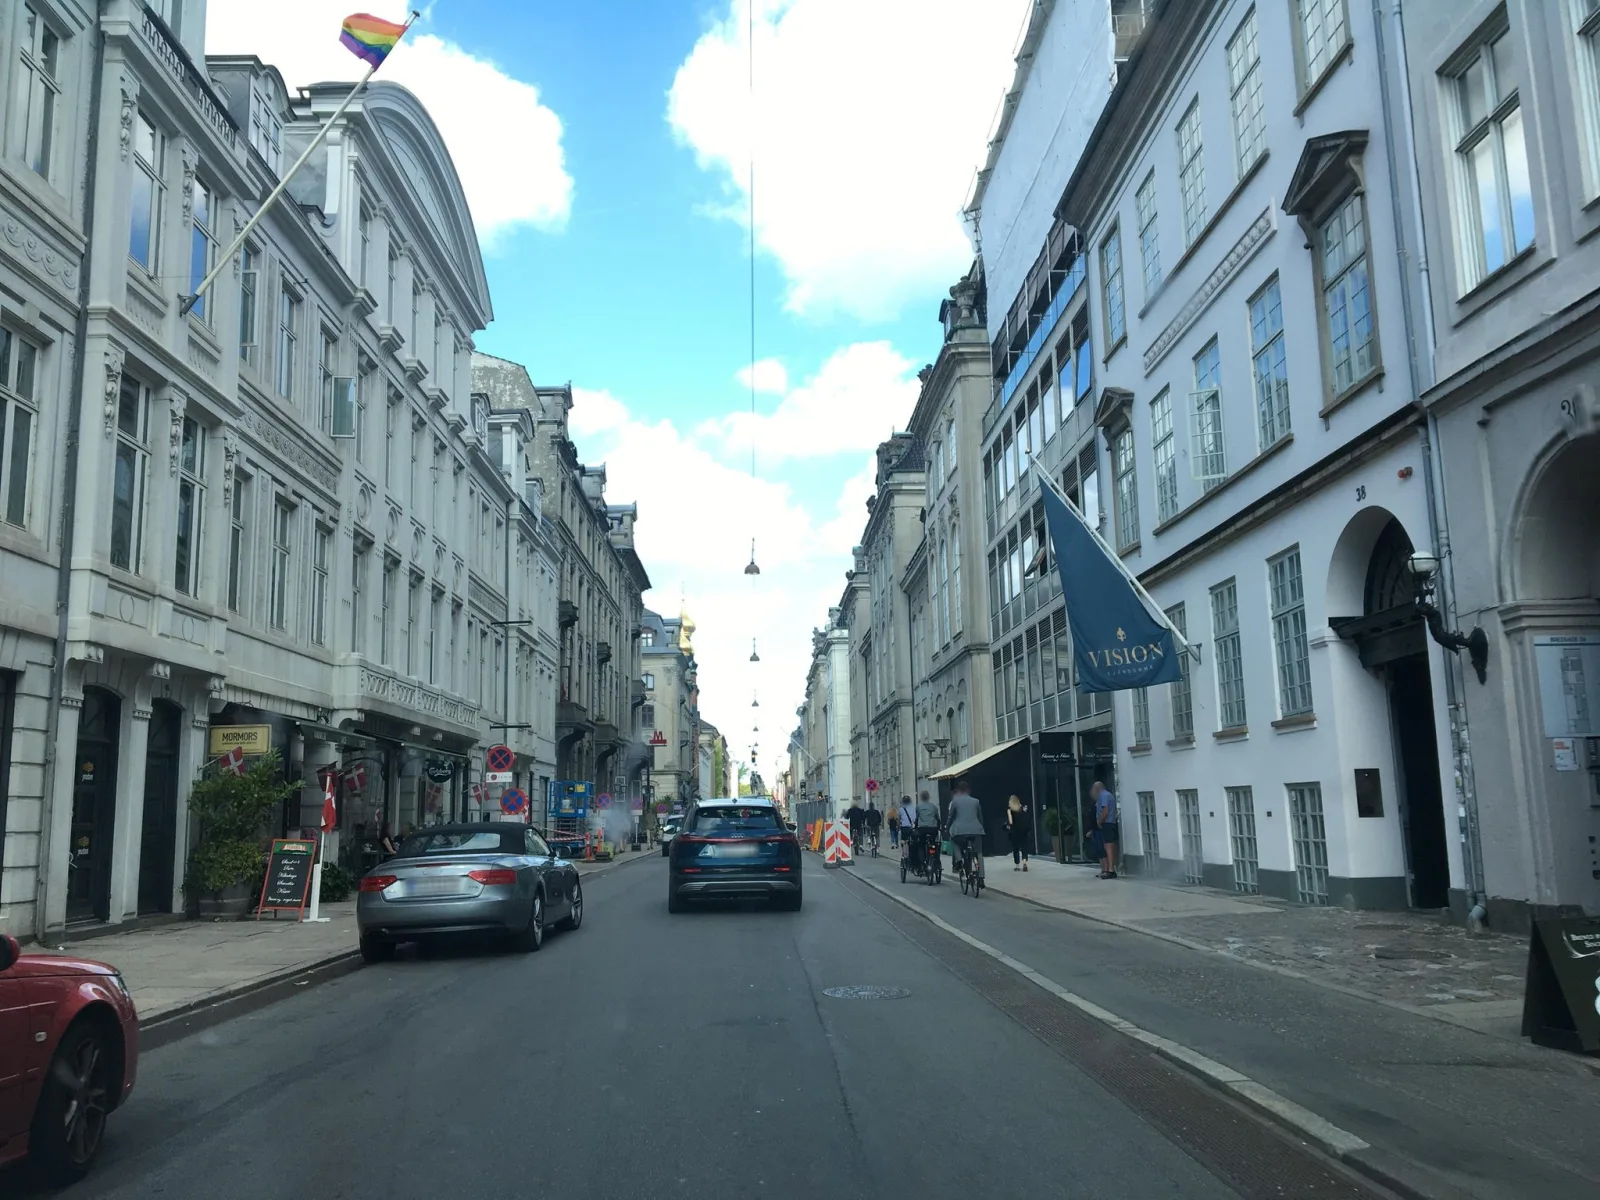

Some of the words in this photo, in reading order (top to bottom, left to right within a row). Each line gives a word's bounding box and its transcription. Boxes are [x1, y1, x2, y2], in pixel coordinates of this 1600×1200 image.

[1355, 484, 1367, 502] 38
[1088, 641, 1164, 668] VISION
[221, 731, 258, 742] MORMORS
